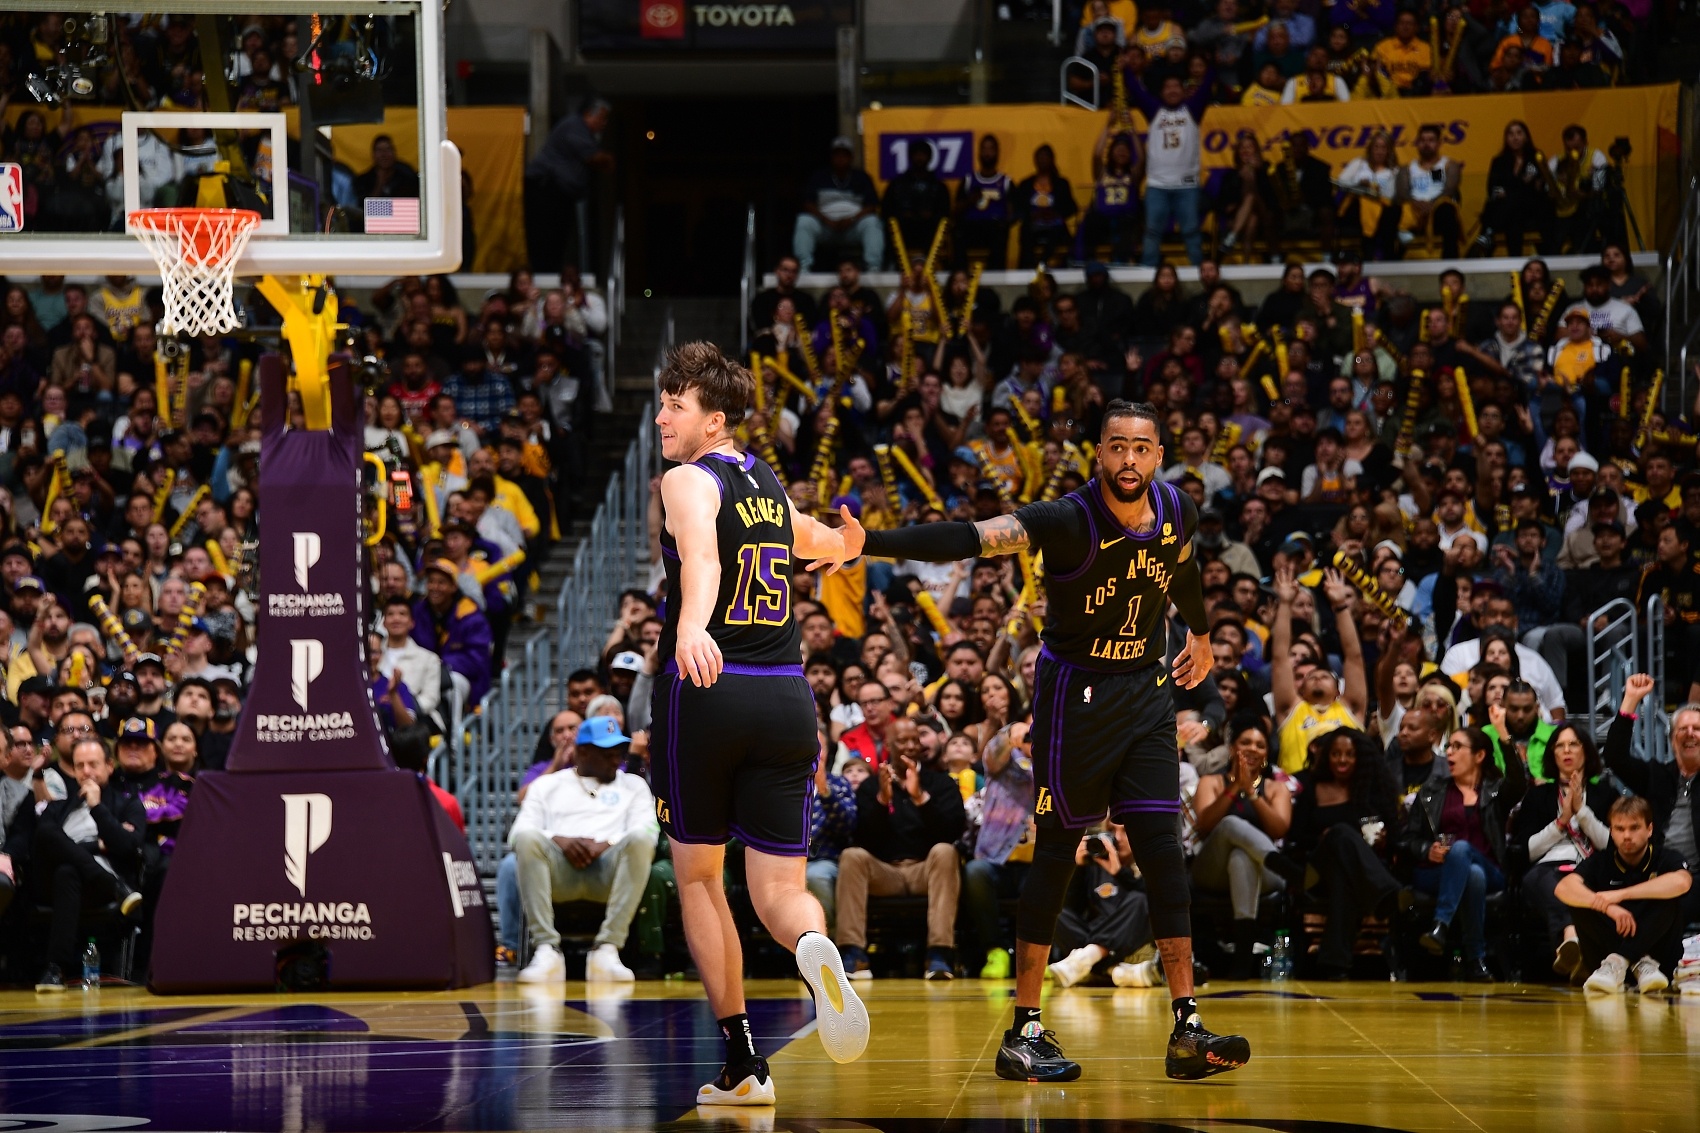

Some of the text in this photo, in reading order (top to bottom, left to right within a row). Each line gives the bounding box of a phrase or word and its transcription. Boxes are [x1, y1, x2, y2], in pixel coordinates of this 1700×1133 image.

[693, 5, 795, 27] TOYOTA
[725, 542, 790, 627] 15
[1084, 549, 1173, 614] LOS ANGELE
[268, 592, 344, 608] PECHANGA
[268, 607, 306, 617] RESORT
[1119, 594, 1142, 637] 1
[1090, 637, 1147, 660] LAKERS
[256, 711, 354, 732] PECHANGA
[256, 729, 304, 743] RESORT
[233, 902, 371, 925] PECHANGA
[232, 925, 301, 942] RESORT
